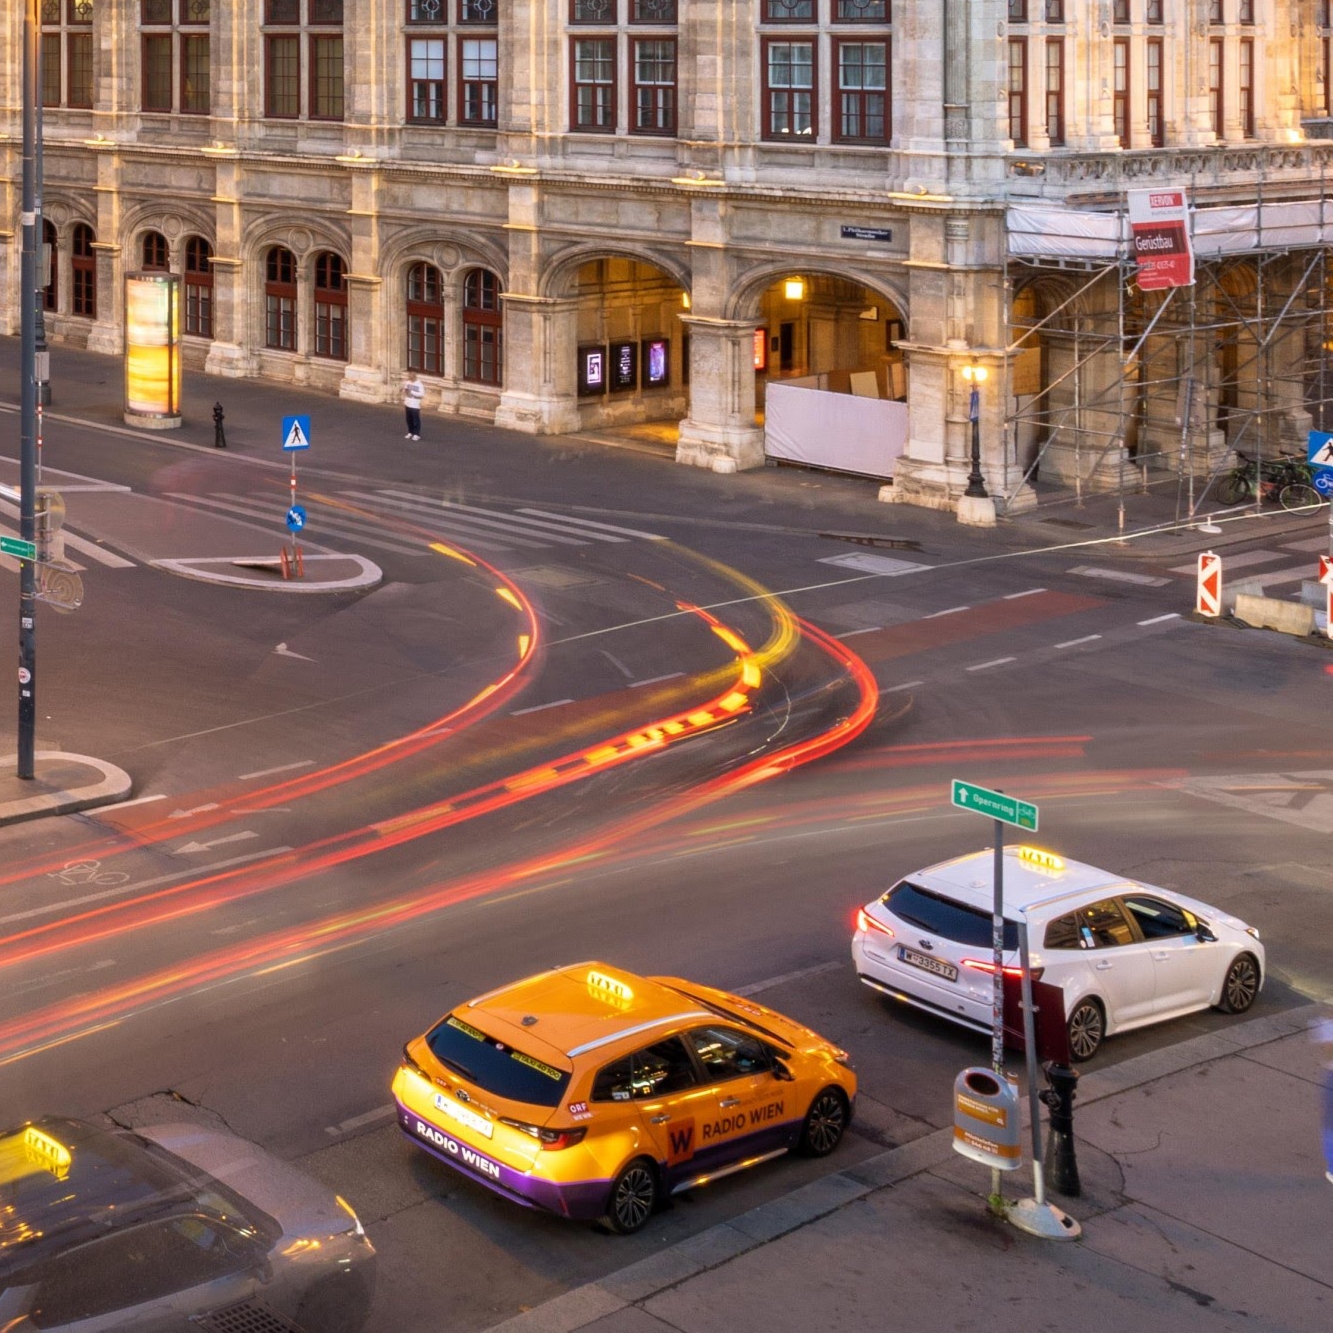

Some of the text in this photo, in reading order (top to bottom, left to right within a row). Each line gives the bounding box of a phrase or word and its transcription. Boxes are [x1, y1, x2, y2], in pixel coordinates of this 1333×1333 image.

[1135, 233, 1173, 251] Gerüstbau
[972, 793, 1015, 817] Opernring
[905, 952, 954, 977] W 3355 TX
[590, 973, 624, 997] TAXI
[570, 1102, 586, 1113] ORF
[703, 1100, 784, 1140] RADIO WIEN
[417, 1121, 500, 1178] RADIO WIEN
[670, 1126, 693, 1155] W
